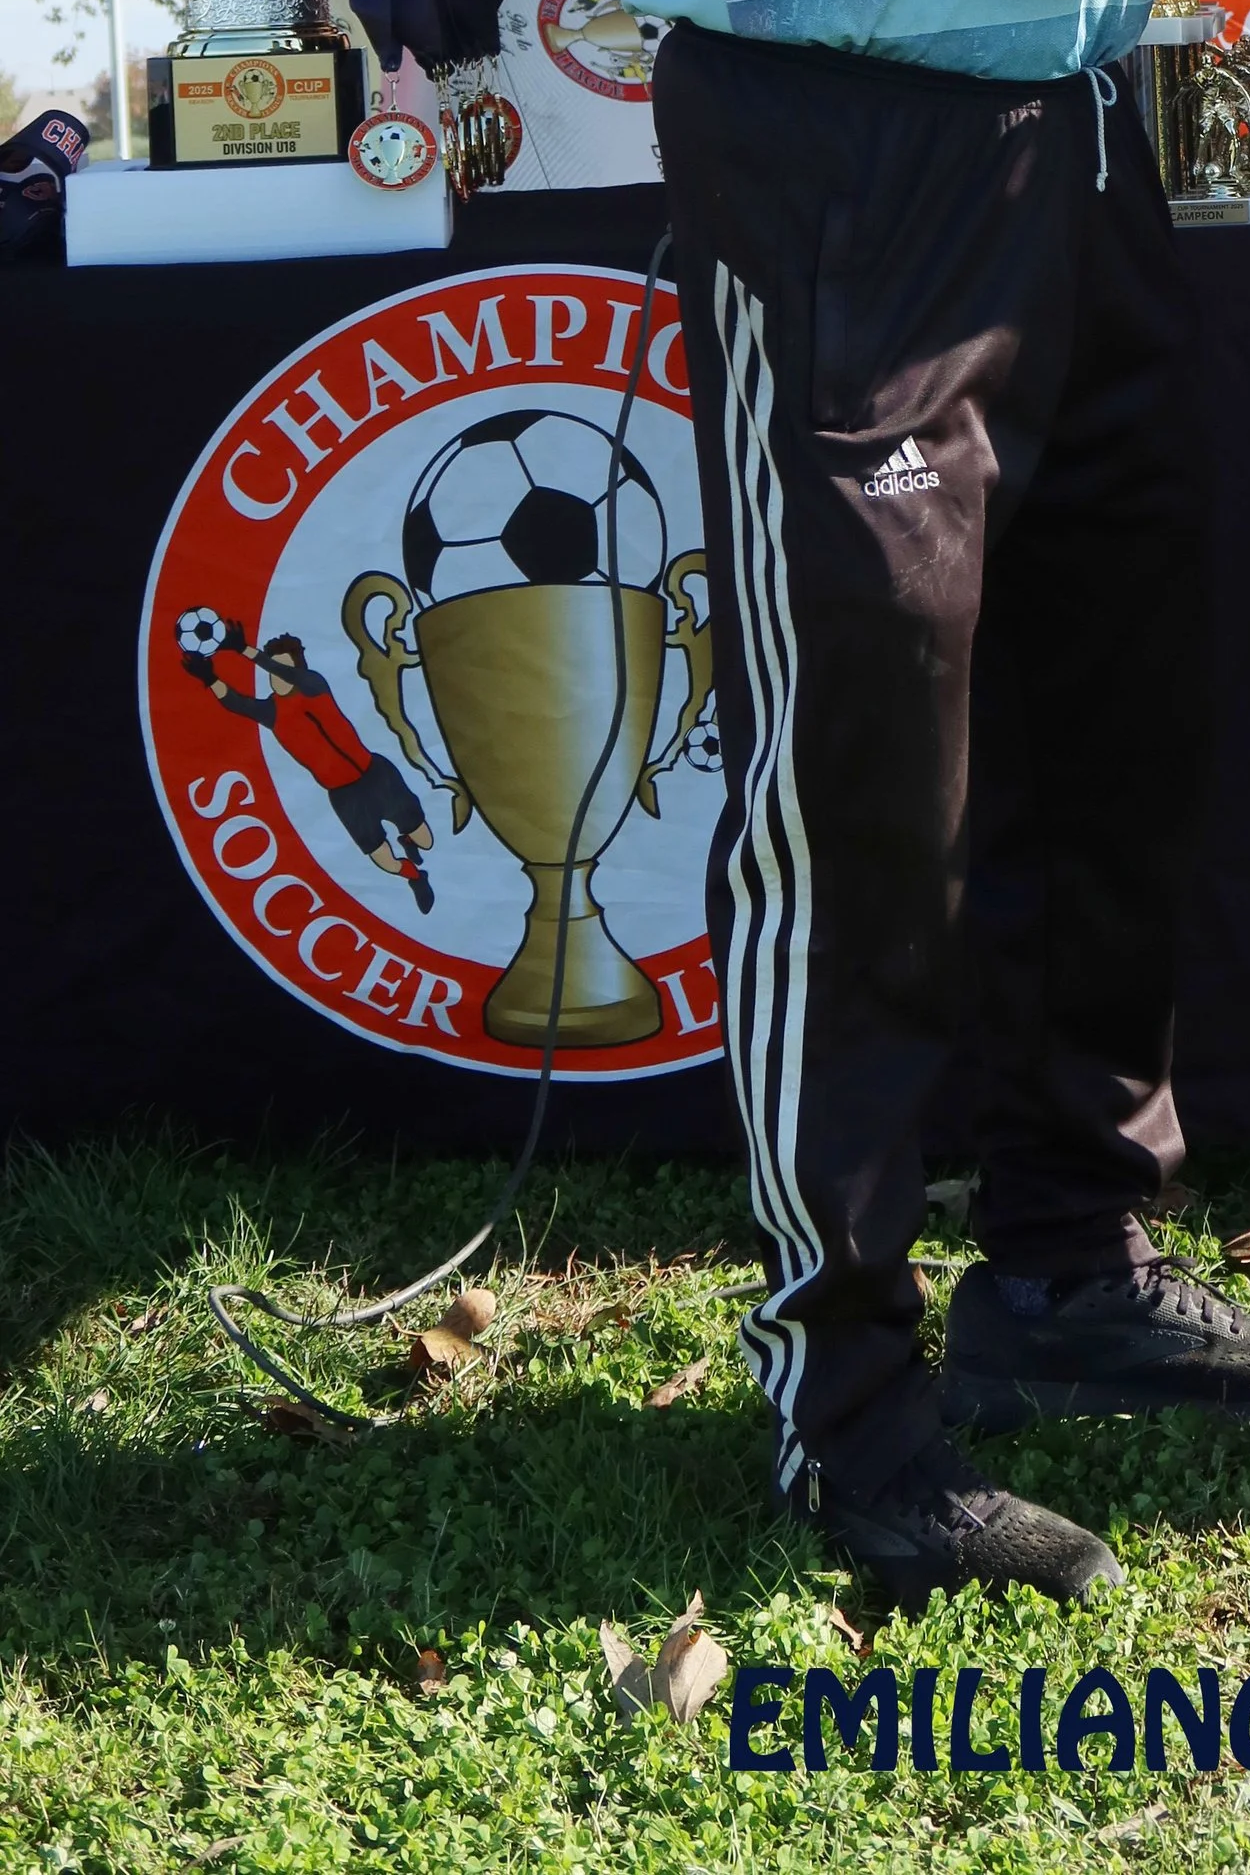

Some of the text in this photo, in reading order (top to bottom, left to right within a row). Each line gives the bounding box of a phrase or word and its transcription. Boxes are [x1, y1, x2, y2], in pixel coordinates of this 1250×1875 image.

[229, 60, 279, 78] CHAMPIONS
[188, 80, 323, 96] 2025 CUP
[211, 121, 301, 142] 2ND PLACE
[223, 141, 296, 155] DIVISION U18
[864, 471, 941, 497] adidas
[187, 768, 464, 1039] SOCCER
